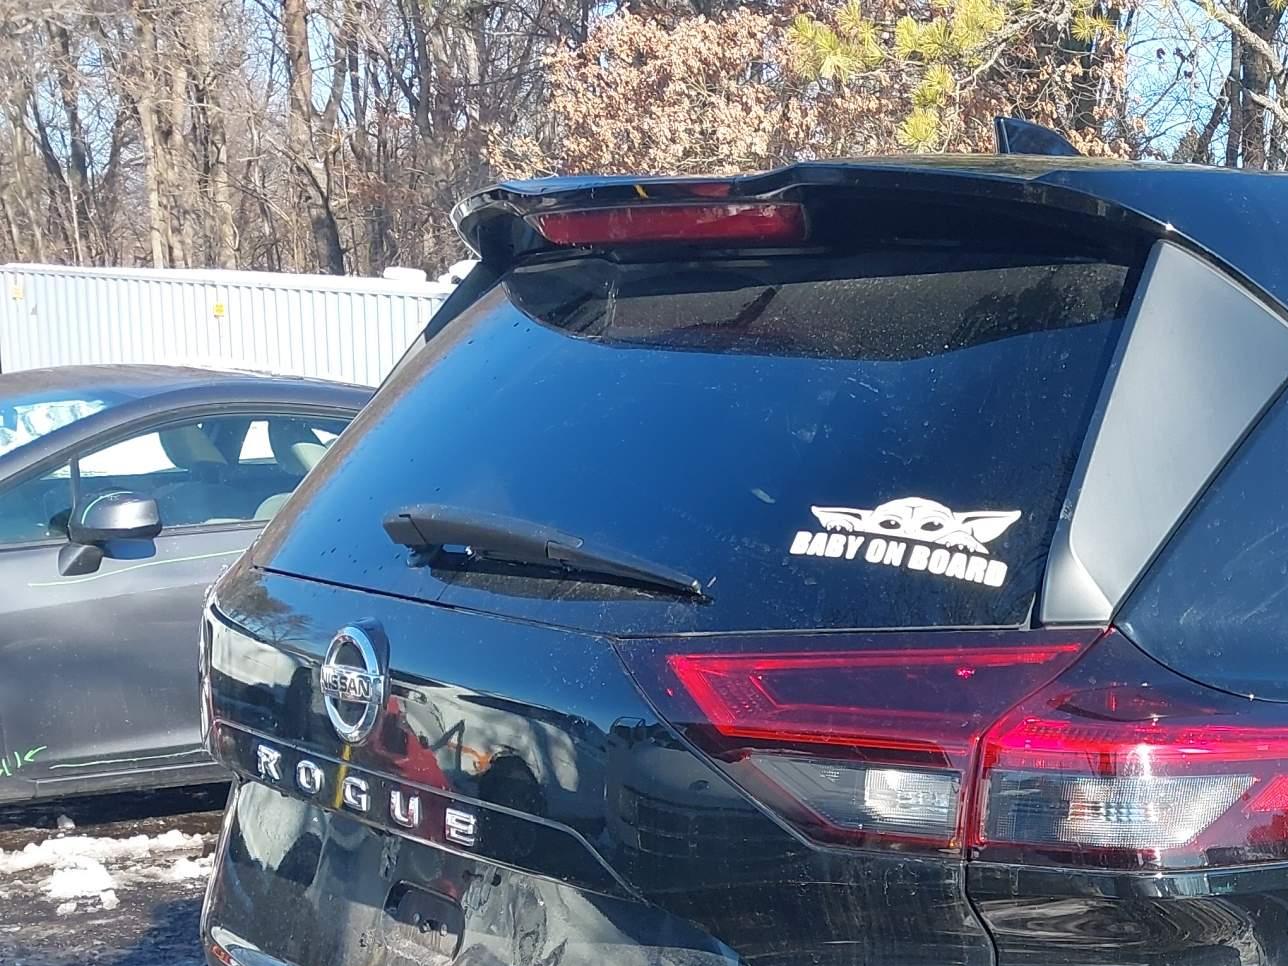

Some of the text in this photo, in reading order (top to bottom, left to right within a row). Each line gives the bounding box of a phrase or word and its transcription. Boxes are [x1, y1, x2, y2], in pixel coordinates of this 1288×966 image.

[790, 530, 1008, 587] BABY ON BOARD
[321, 667, 370, 698] NISSAN
[257, 744, 476, 847] ROGUE
